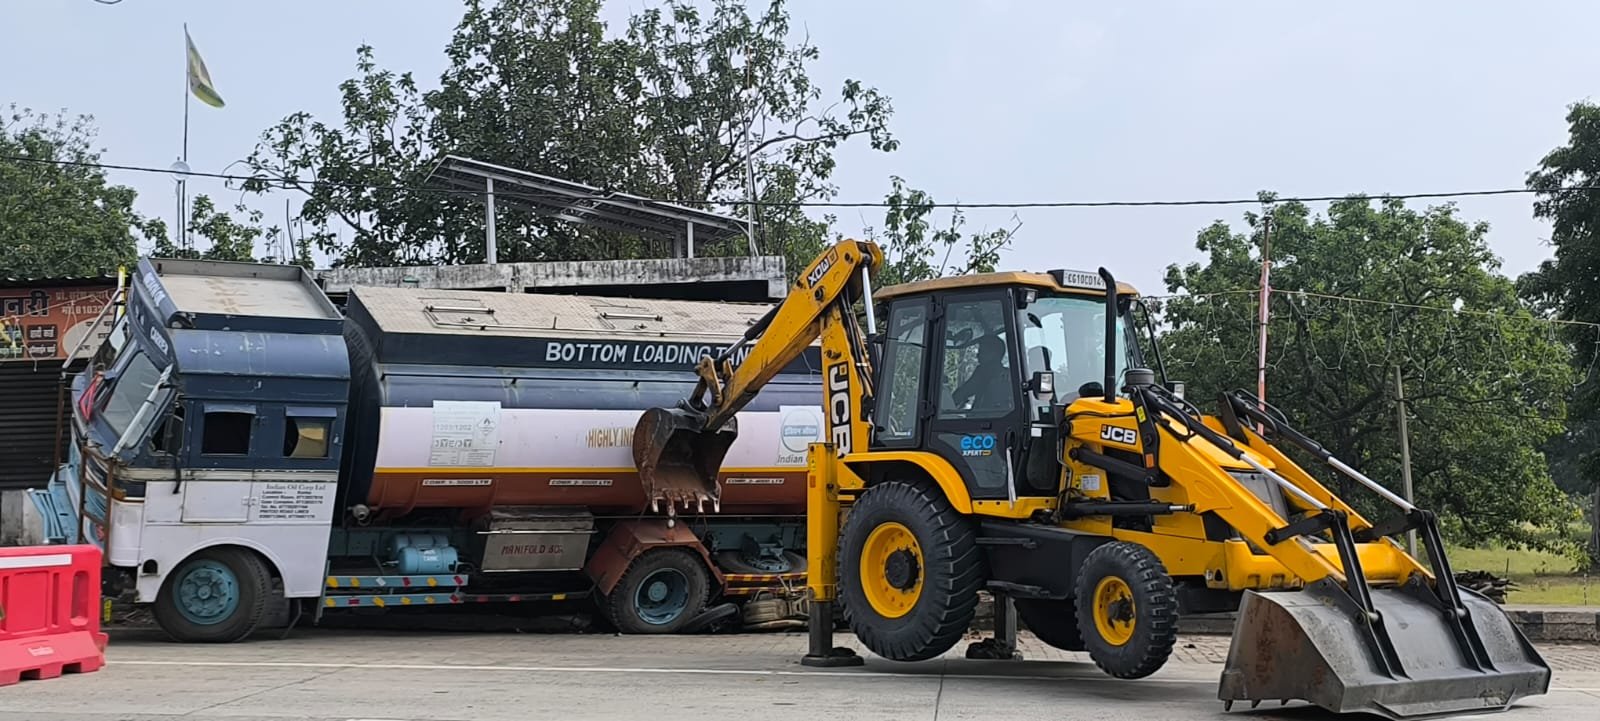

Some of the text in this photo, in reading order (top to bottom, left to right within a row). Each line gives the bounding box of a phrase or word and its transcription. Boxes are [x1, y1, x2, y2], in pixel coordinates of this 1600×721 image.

[545, 342, 628, 364] BOTTOM
[633, 344, 711, 365] LOADING
[829, 365, 851, 458] JCB
[588, 427, 618, 448] HIGHLY
[960, 435, 994, 450] eco
[1101, 426, 1137, 444] JCB
[777, 454, 804, 464] Indian
[501, 543, 546, 556] MANIFOLD
